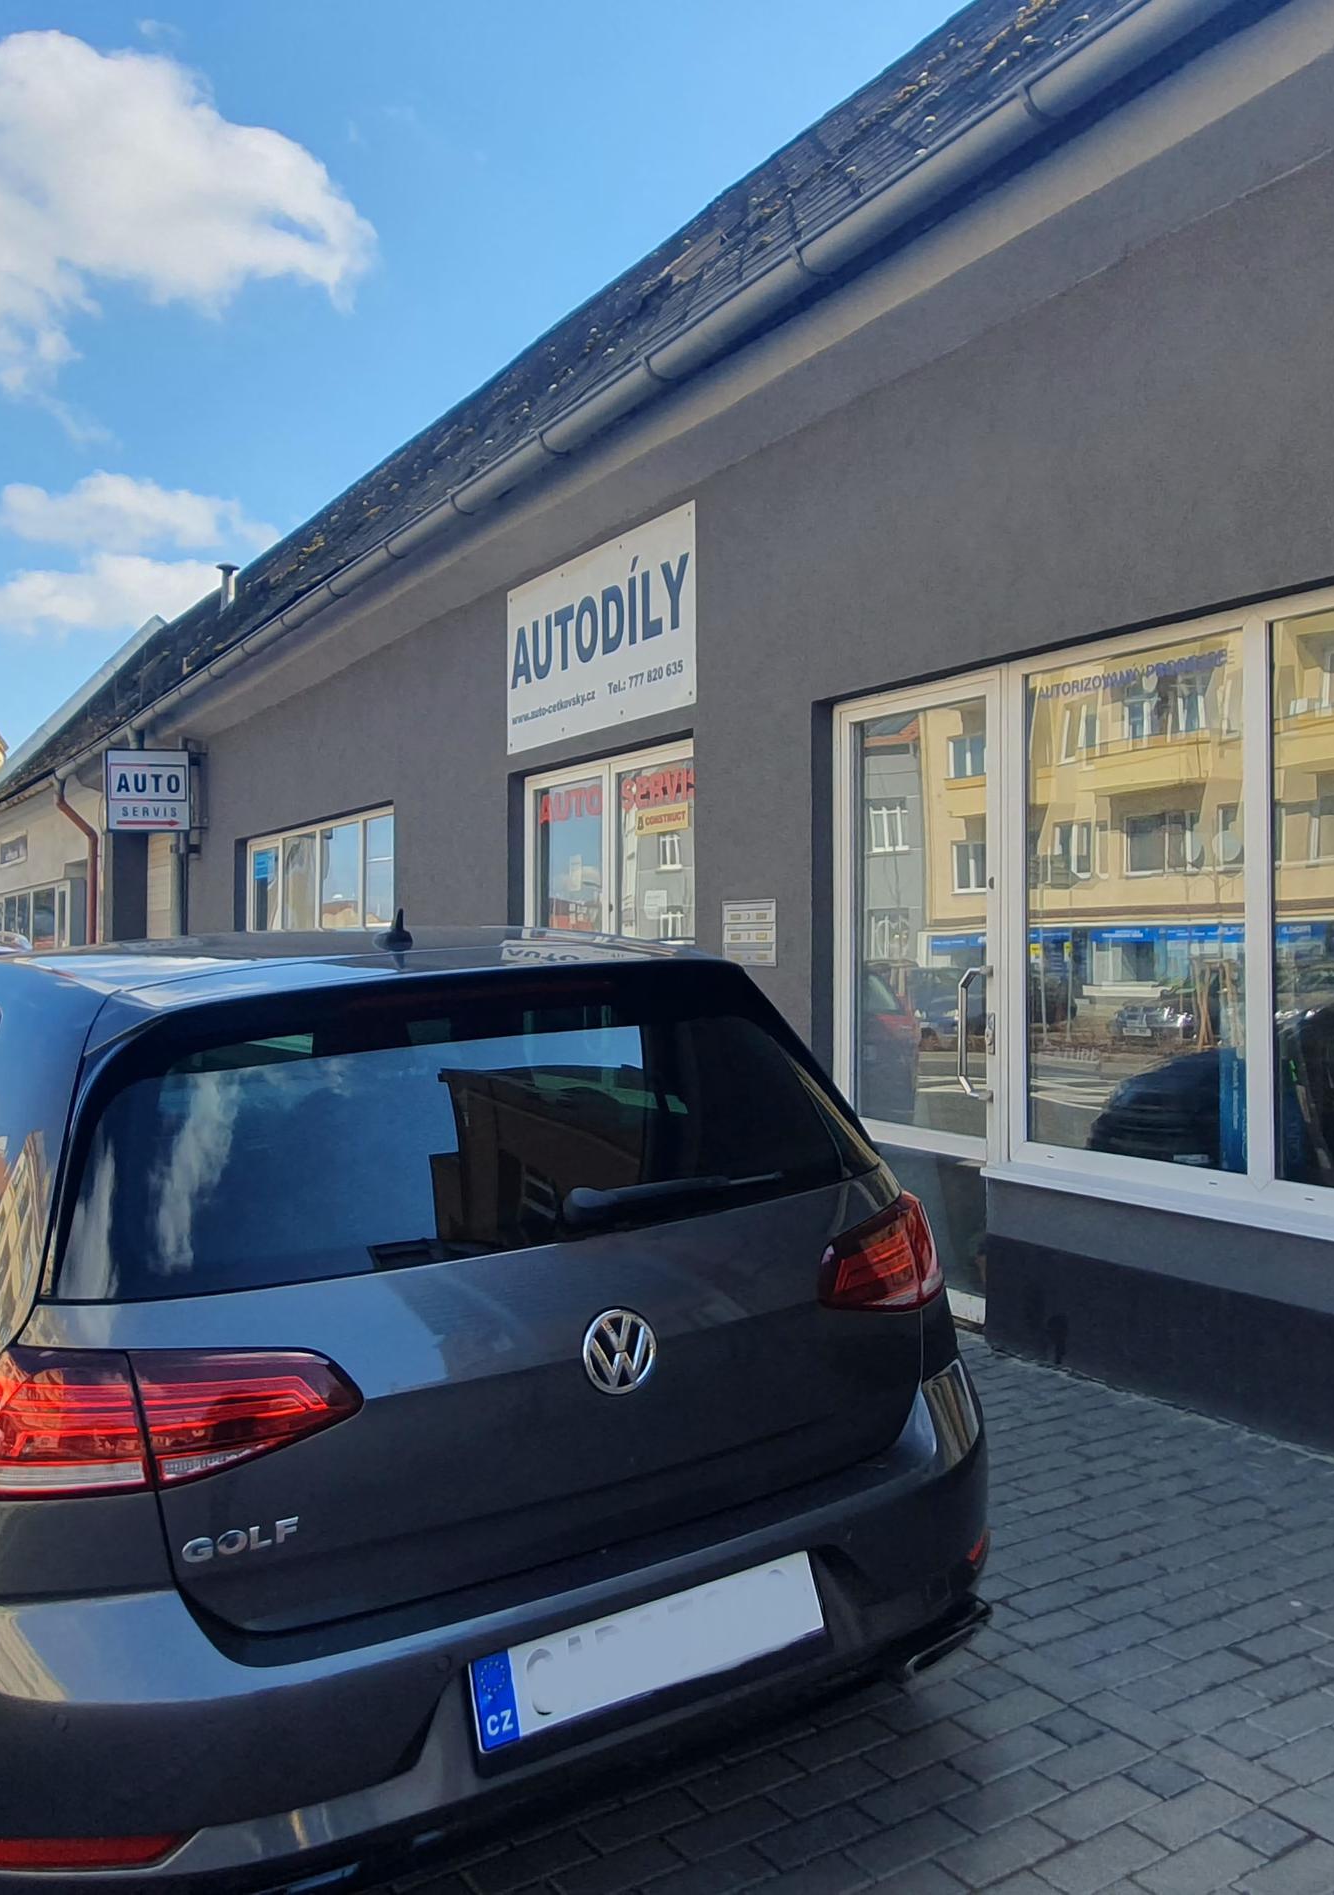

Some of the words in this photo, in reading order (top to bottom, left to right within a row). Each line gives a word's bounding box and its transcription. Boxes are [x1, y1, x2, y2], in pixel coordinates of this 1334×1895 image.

[511, 552, 690, 689] AUTODÍLY
[628, 673, 645, 689] 777
[647, 667, 664, 684] 820
[666, 660, 684, 677] 635
[116, 772, 182, 794] AUTO
[121, 806, 179, 818] SERVIS
[539, 784, 603, 825] AUTO
[182, 1515, 299, 1564] GOLF
[485, 1709, 515, 1737] CZ
